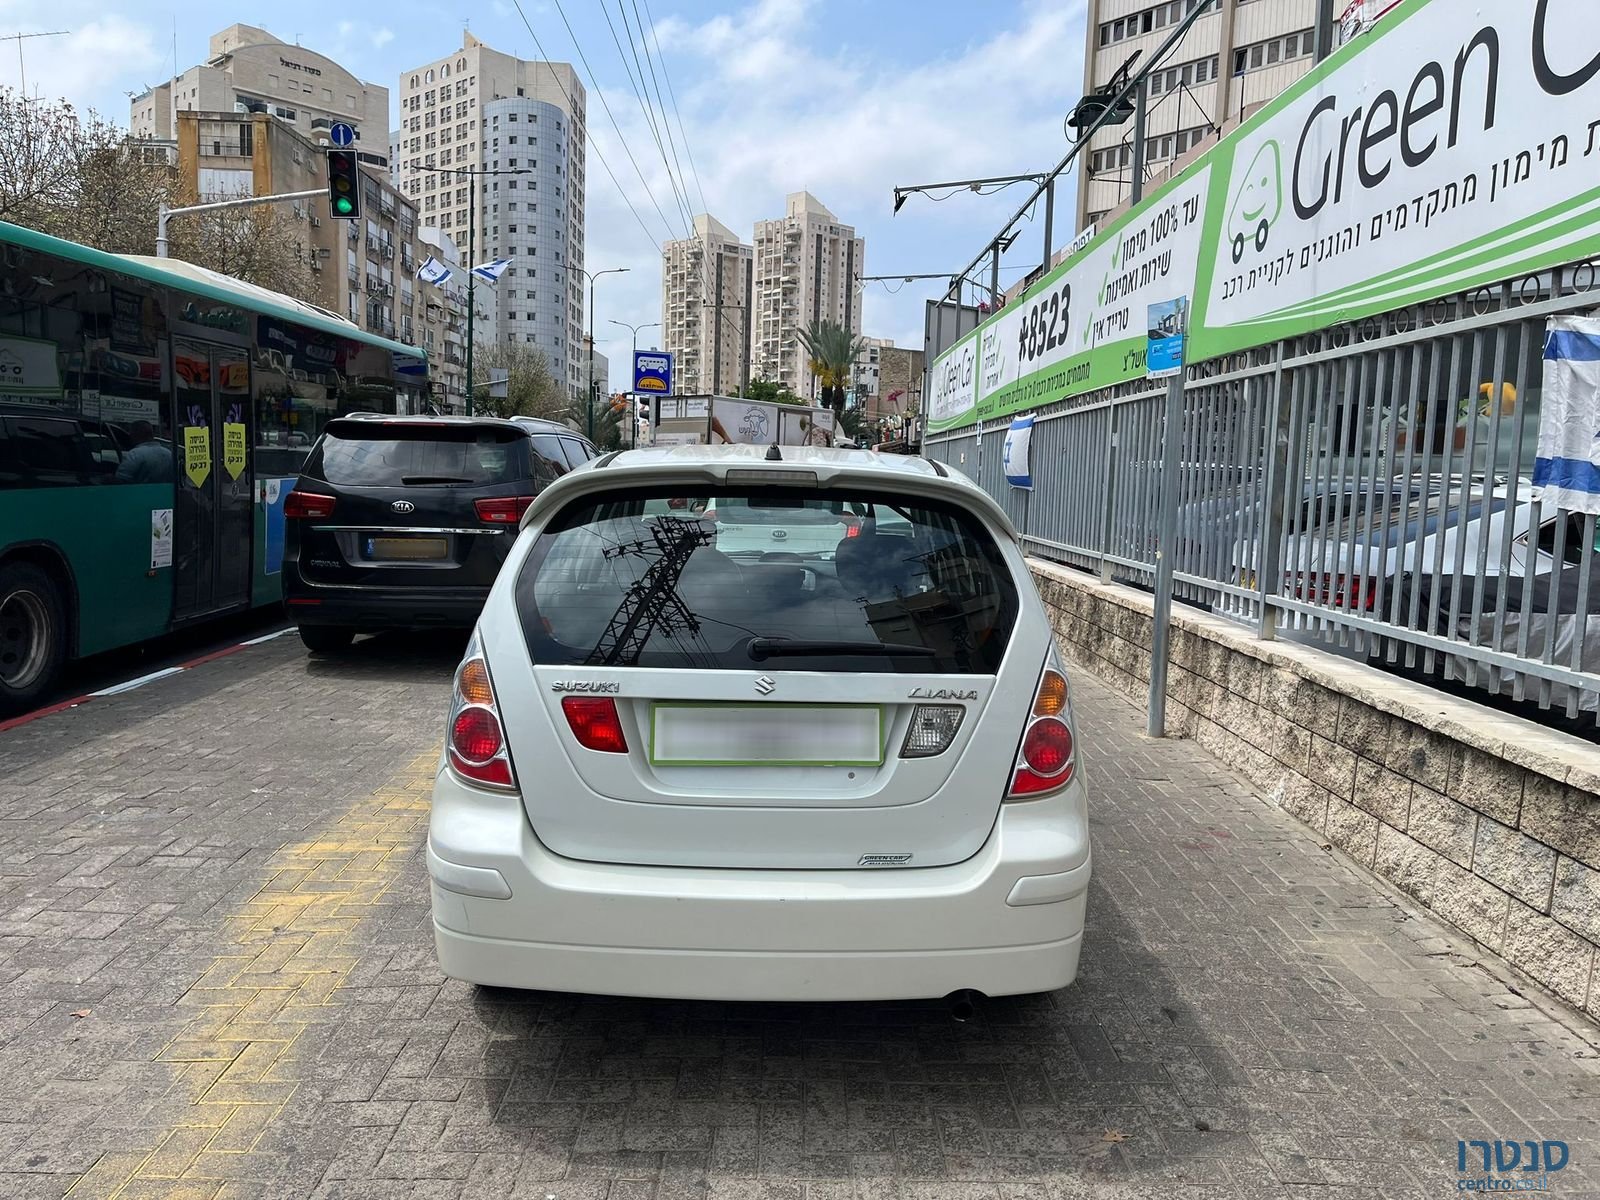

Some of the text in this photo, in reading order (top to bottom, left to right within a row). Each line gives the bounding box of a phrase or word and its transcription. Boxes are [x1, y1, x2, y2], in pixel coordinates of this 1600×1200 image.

[1292, 26, 1500, 221] Green
[1490, 134, 1569, 203] מימון
[1370, 173, 1478, 242] מתקדמים
[1121, 193, 1200, 271] עד 100% מימון
[1300, 223, 1362, 270] והוגנים
[1104, 248, 1172, 306] שירות ואמינות
[1221, 275, 1244, 301] רכב
[1247, 247, 1295, 291] לקניית
[1091, 306, 1129, 350] טרייד אין
[551, 680, 621, 693] SUZUKI
[907, 686, 978, 701] LIANA
